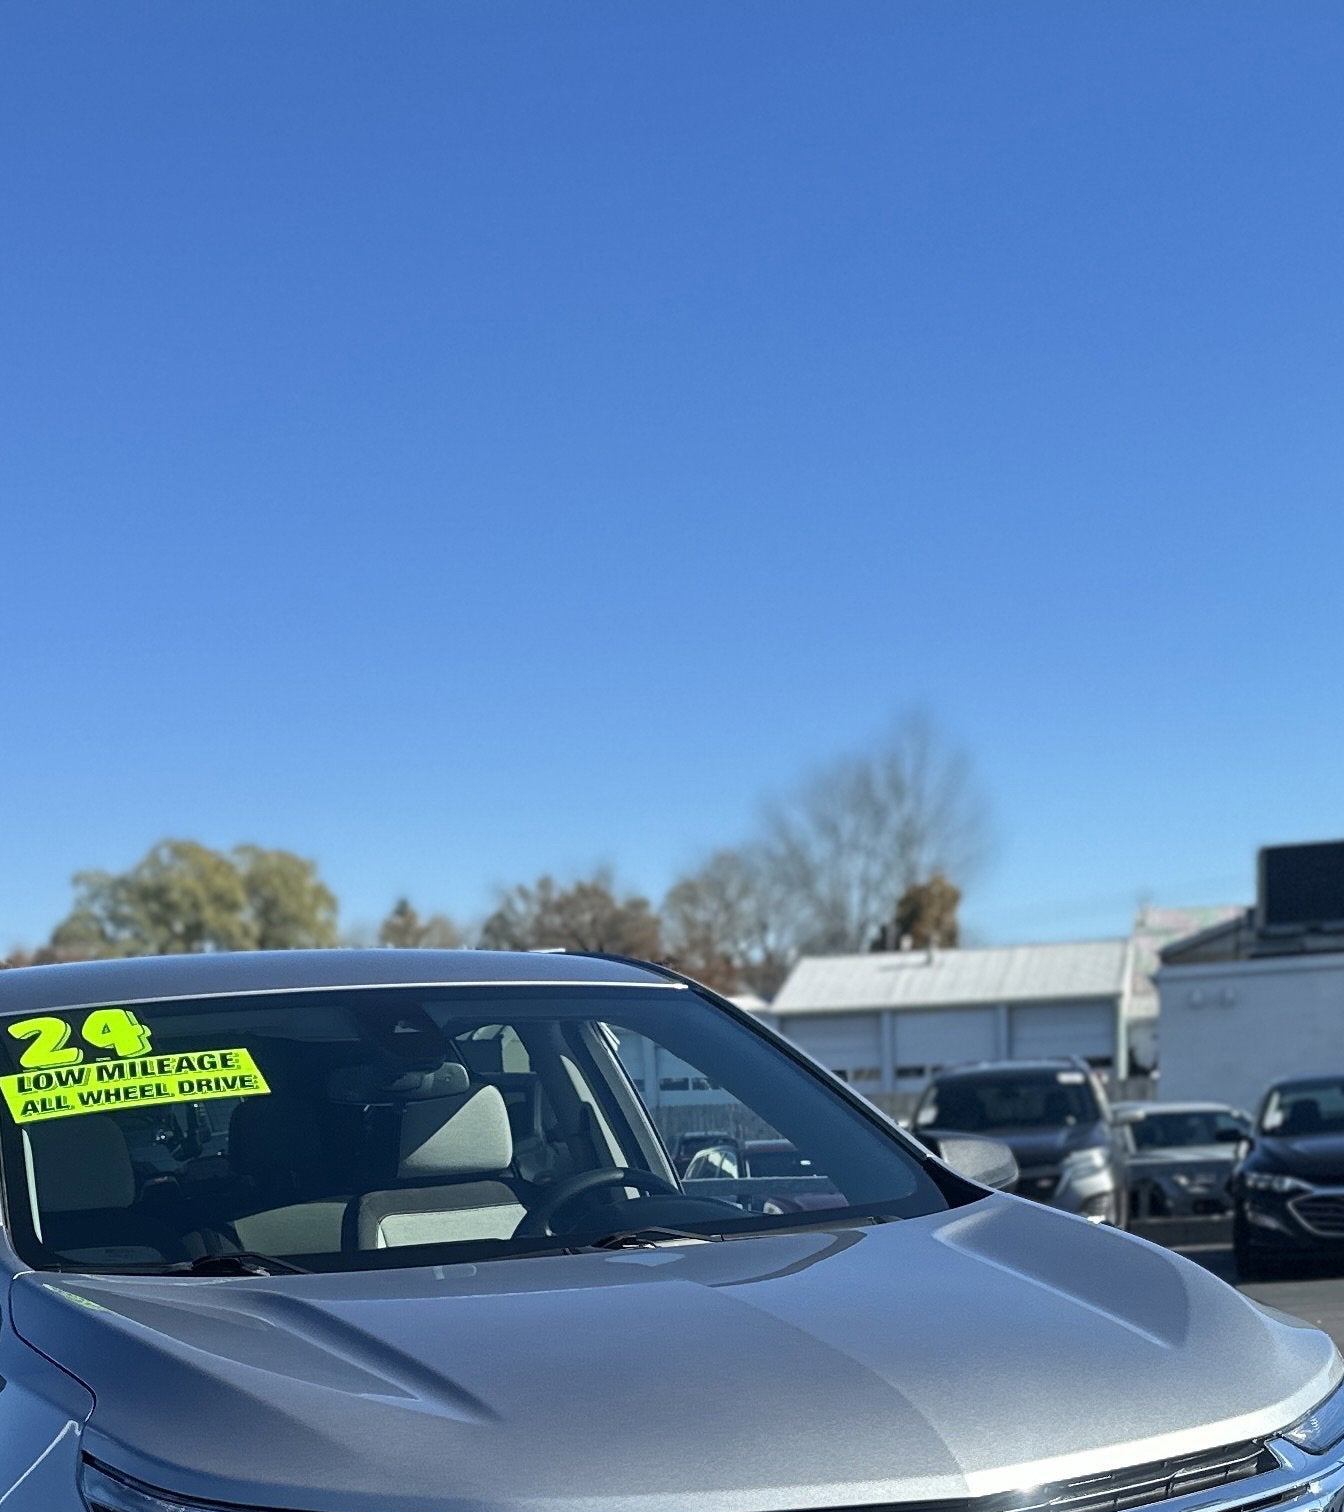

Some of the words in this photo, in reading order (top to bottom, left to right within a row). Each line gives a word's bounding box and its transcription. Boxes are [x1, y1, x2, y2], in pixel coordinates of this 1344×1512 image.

[8, 1008, 152, 1068] 24
[17, 1067, 89, 1094] LOW
[96, 1051, 240, 1083] MILEAGE
[20, 1096, 73, 1116] ALL
[77, 1083, 174, 1107] WHEEL
[178, 1074, 259, 1095] DRIVE
